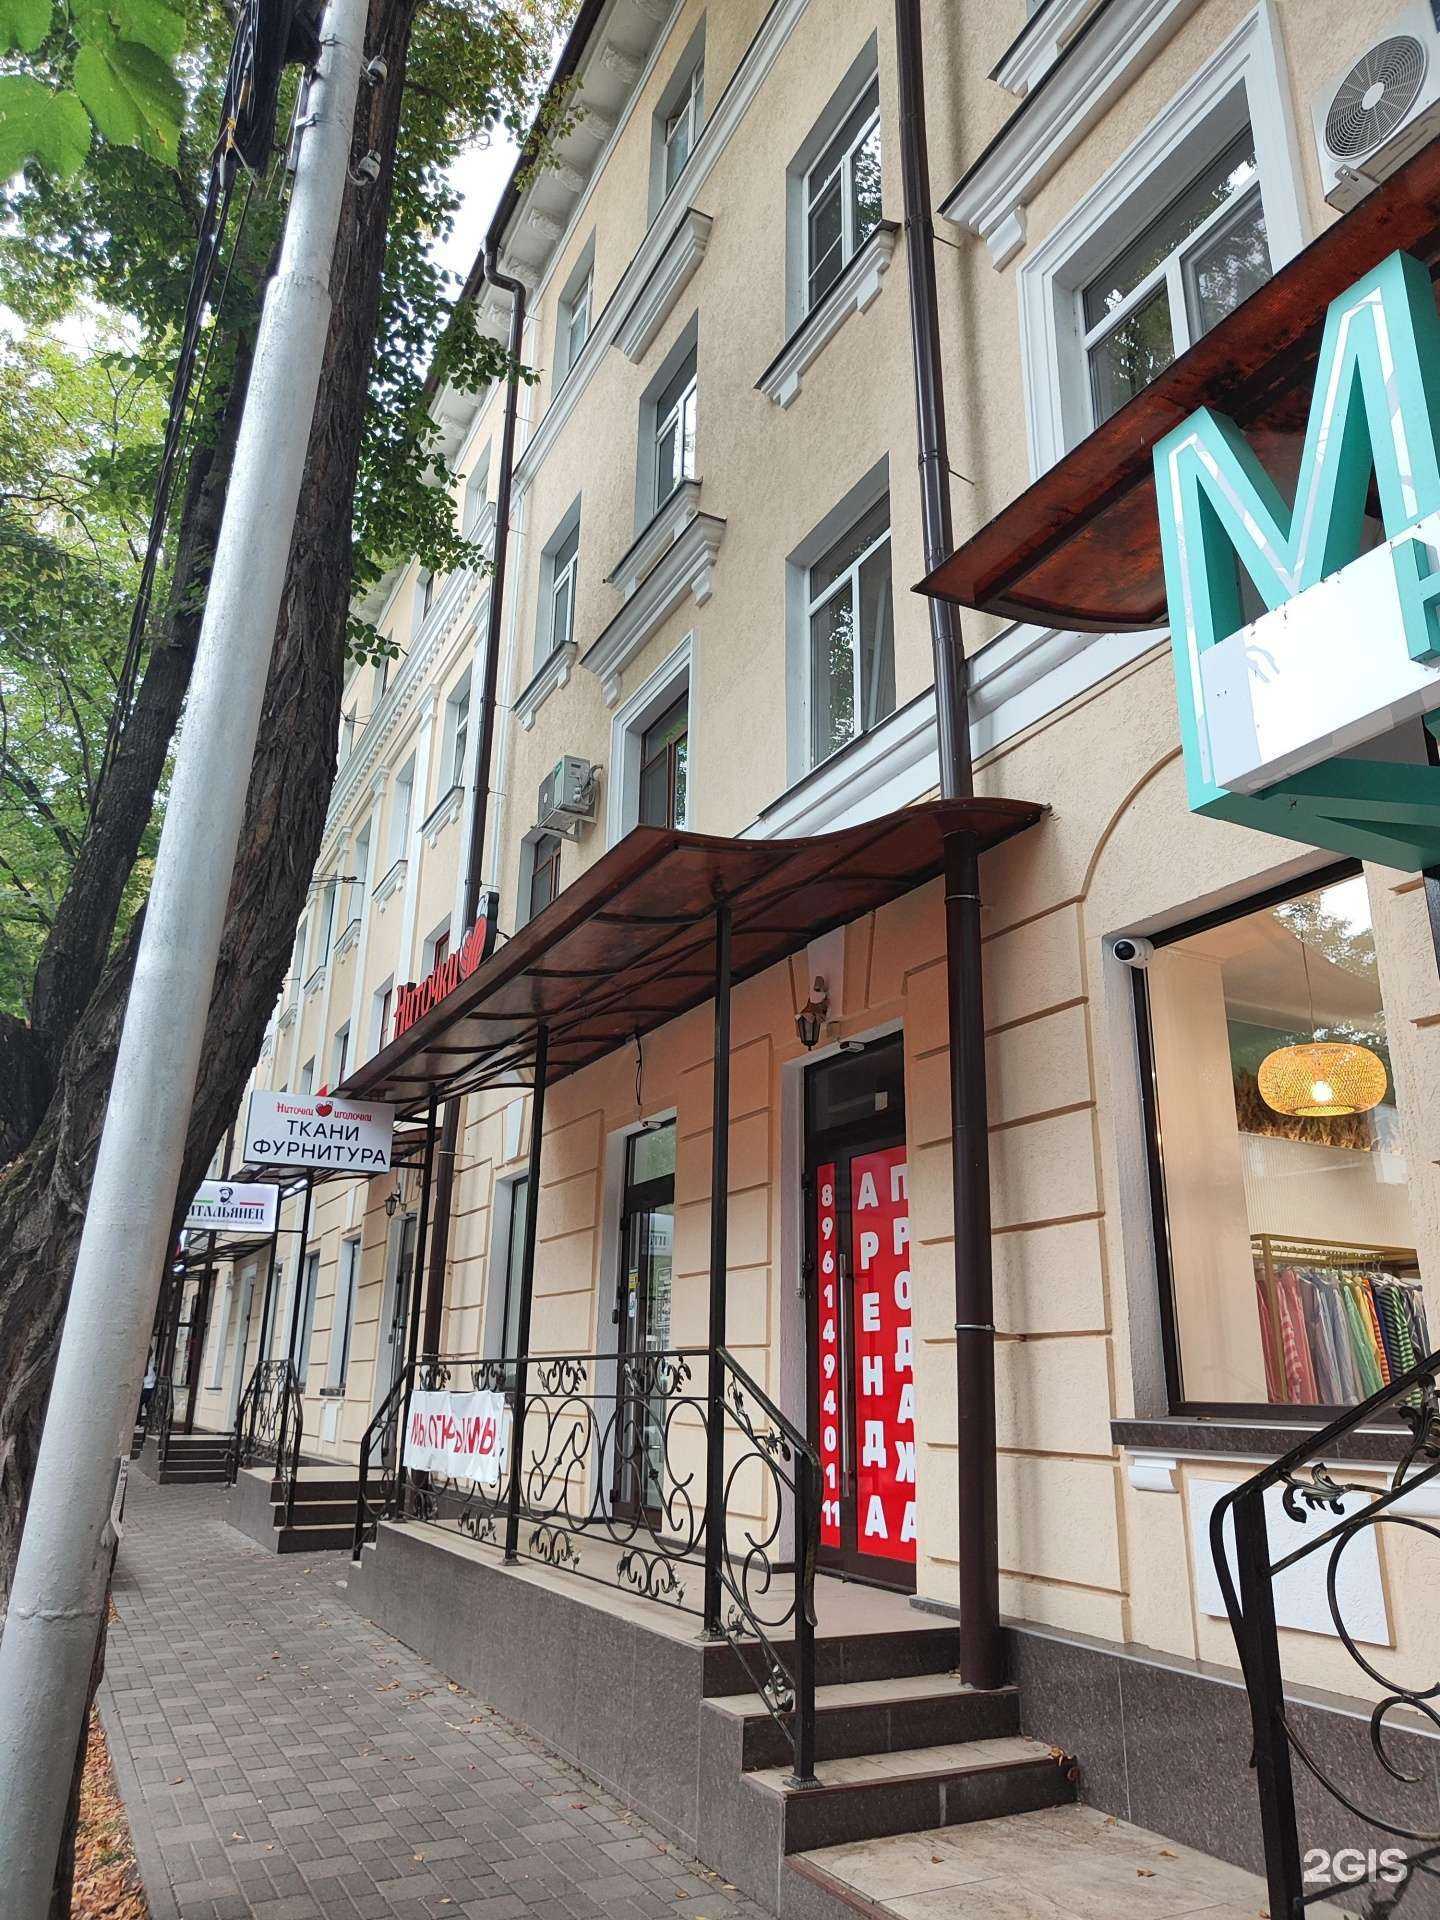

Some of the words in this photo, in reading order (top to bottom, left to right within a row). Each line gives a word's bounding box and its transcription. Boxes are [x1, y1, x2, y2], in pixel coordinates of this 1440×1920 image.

[276, 1102, 313, 1116] Ниточки
[287, 1119, 360, 1142] ТКАНИ
[252, 1138, 386, 1165] ФУРНИТУРА
[857, 1171, 889, 1539] АРЕНДА
